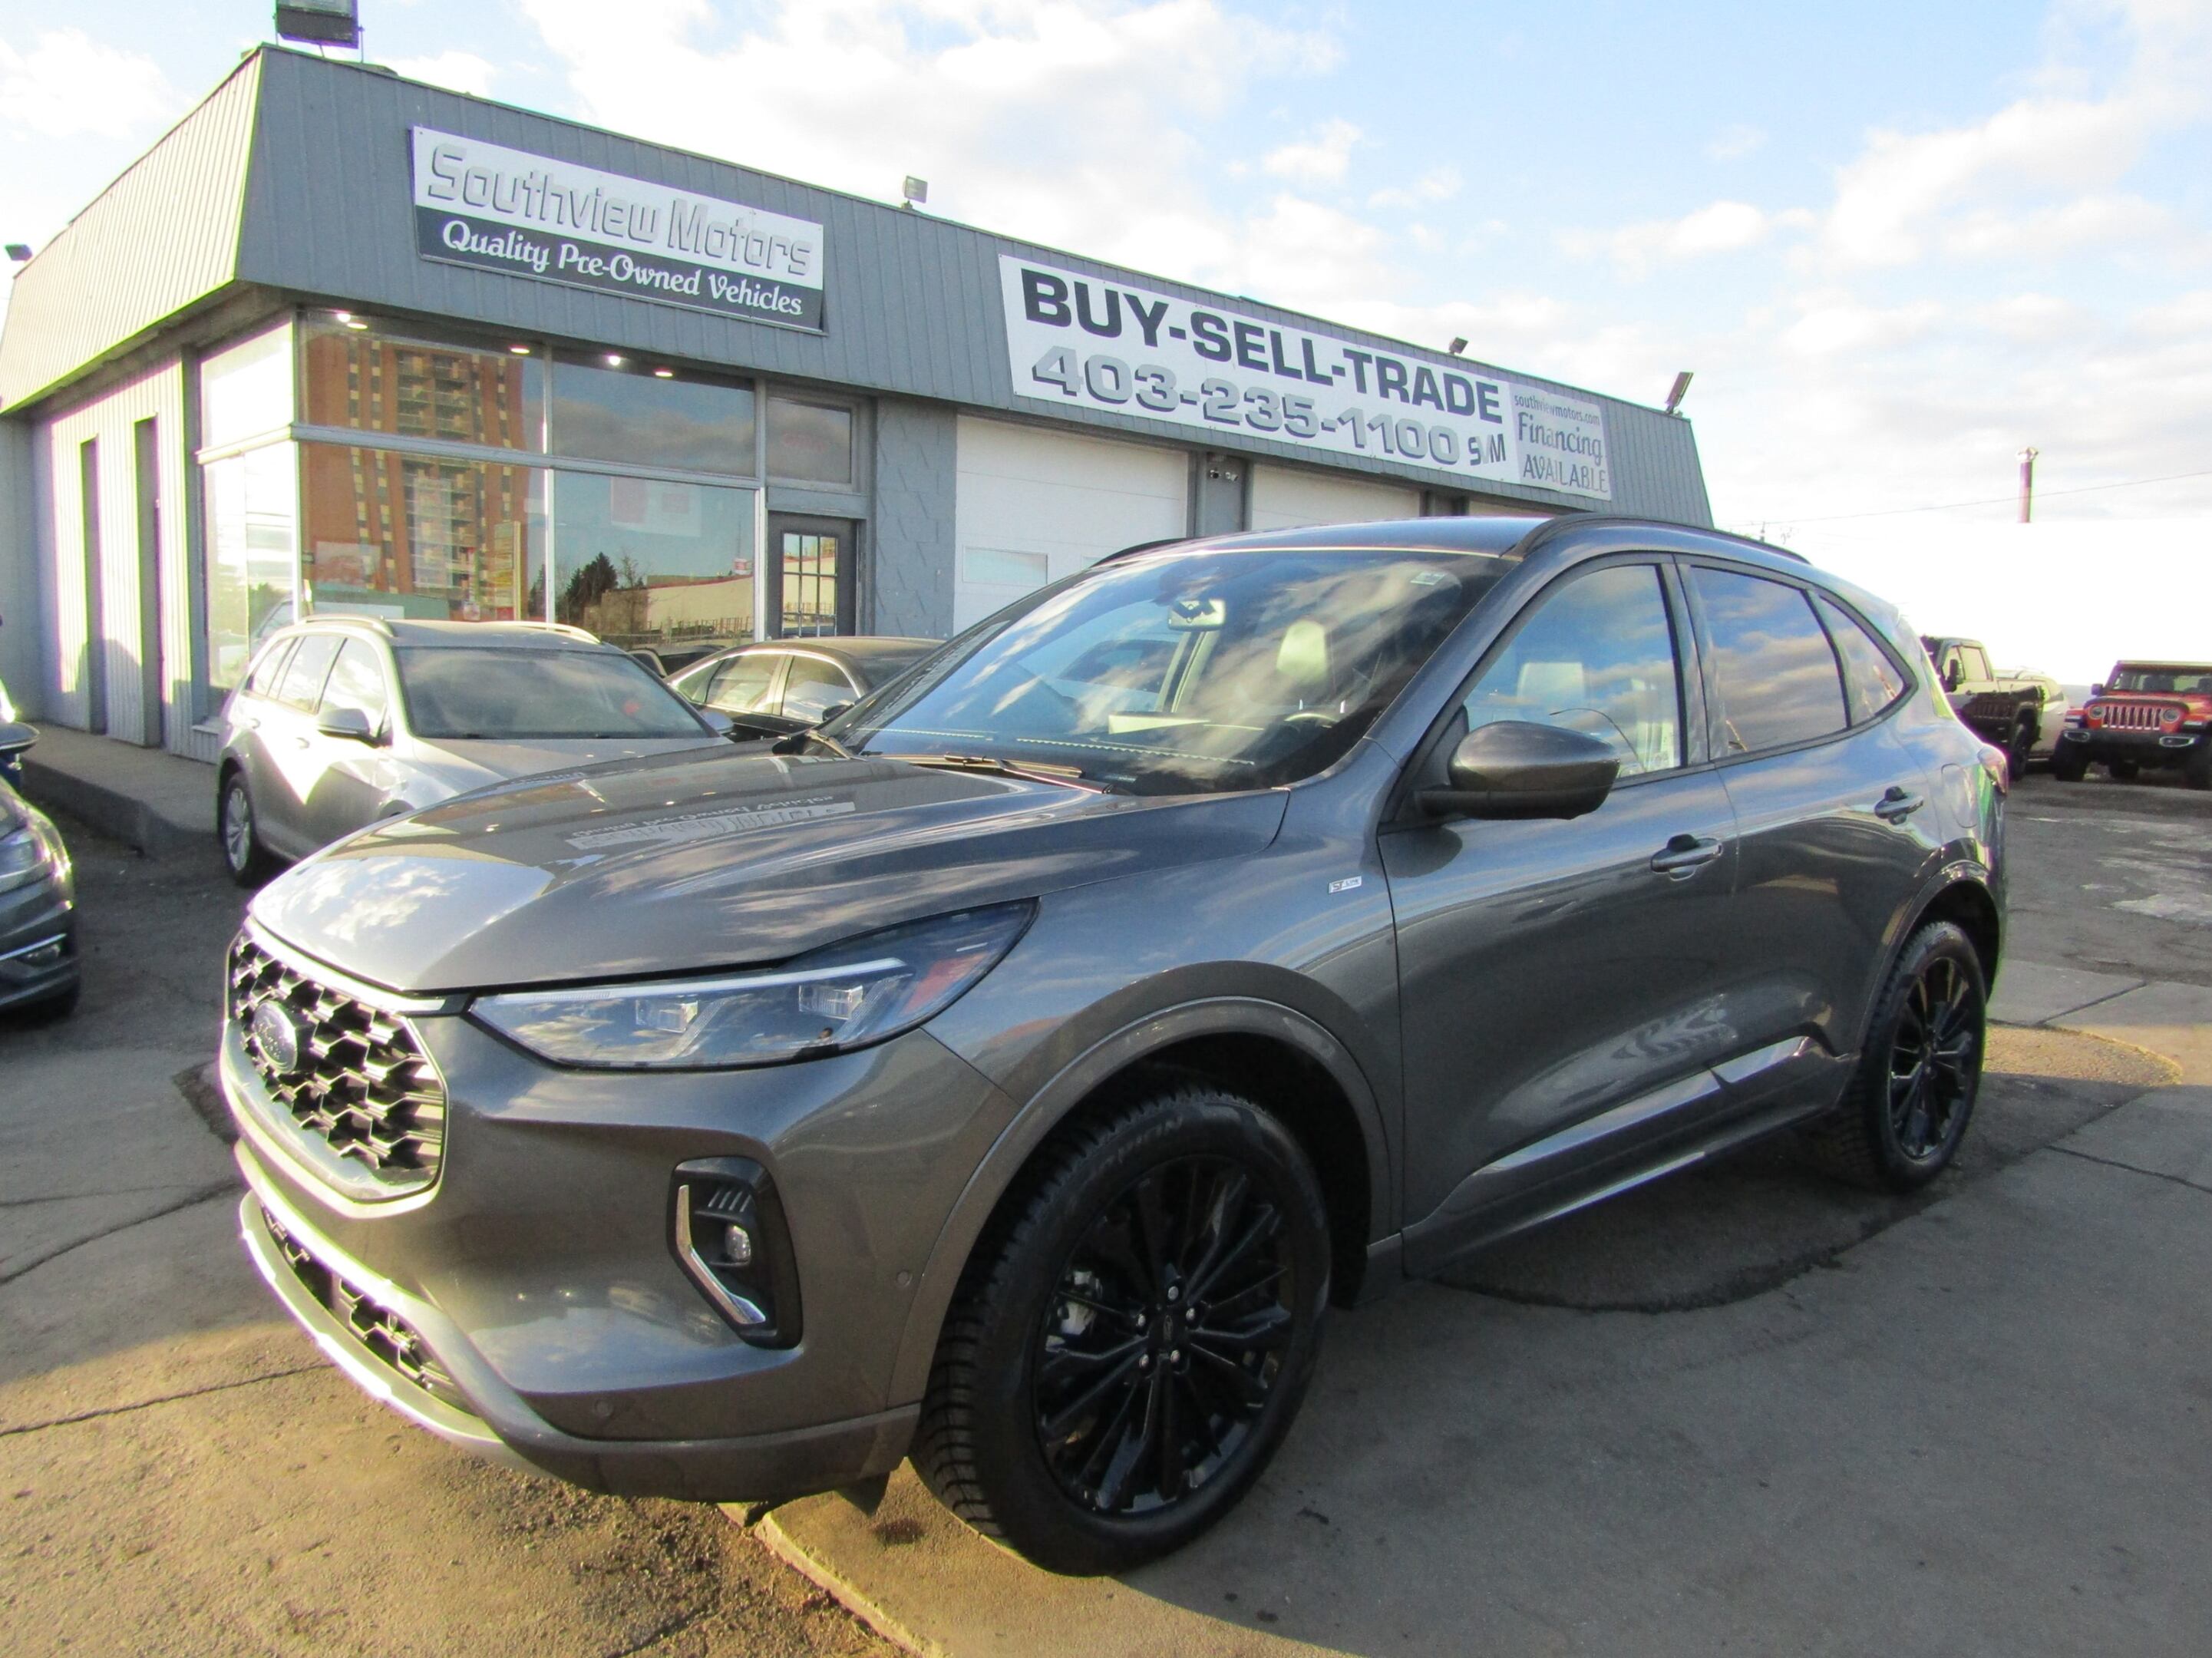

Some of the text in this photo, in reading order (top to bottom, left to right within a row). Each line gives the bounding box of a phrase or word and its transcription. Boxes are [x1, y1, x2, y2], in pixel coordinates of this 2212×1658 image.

[428, 144, 811, 276] Southview Motors
[443, 220, 803, 316] Quality Pre-Owned Vehicles
[1021, 268, 1504, 424] BUY-SELL-TRADE
[1032, 345, 1460, 465] 403-235-1100
[1514, 395, 1600, 425] southviewmotors.com
[1517, 411, 1603, 466] Financing
[1523, 454, 1608, 493] AVAILABLE
